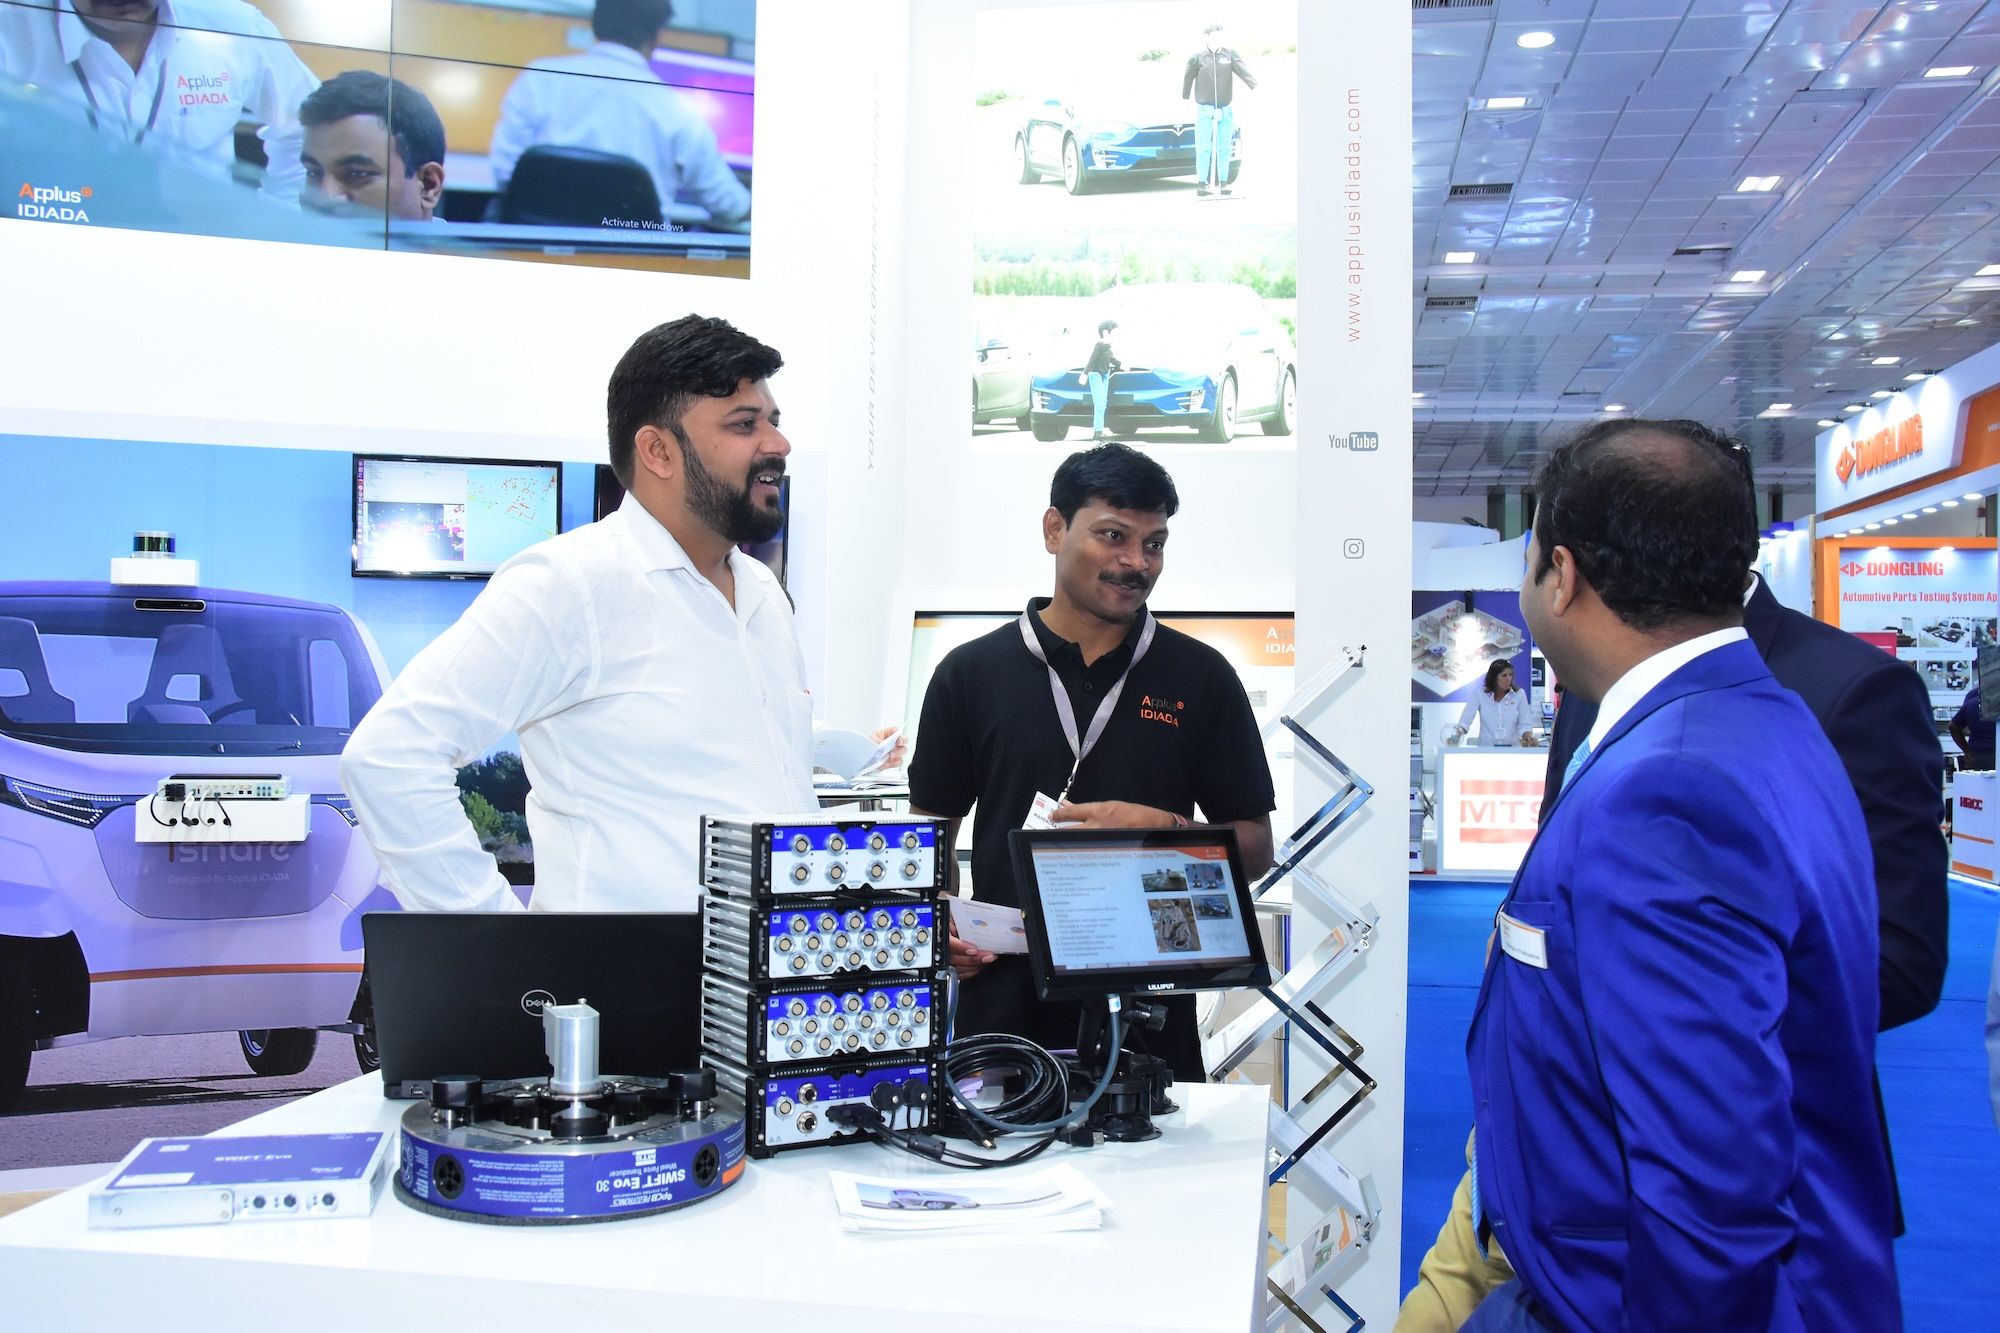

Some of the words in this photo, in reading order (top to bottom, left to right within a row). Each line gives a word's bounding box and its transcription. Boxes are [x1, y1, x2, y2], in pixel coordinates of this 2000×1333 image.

[178, 93, 229, 106] IDIADA
[18, 204, 90, 223] IDIADA
[1344, 88, 1364, 343] www.applusidiada.com
[601, 216, 640, 228] Activate
[641, 220, 684, 232] Windows
[1856, 413, 1923, 476] DONGLING
[1867, 562, 1944, 576] DONGLING
[1842, 592, 1891, 602] Automotive
[1892, 592, 1918, 602] Parts
[1919, 592, 1950, 603] Testing
[1952, 592, 1985, 603] System
[1140, 708, 1179, 728] IDIADA
[609, 1168, 642, 1177] Transducer
[644, 1165, 660, 1173] Force
[596, 1180, 610, 1192] 30
[613, 1177, 640, 1190] Evo
